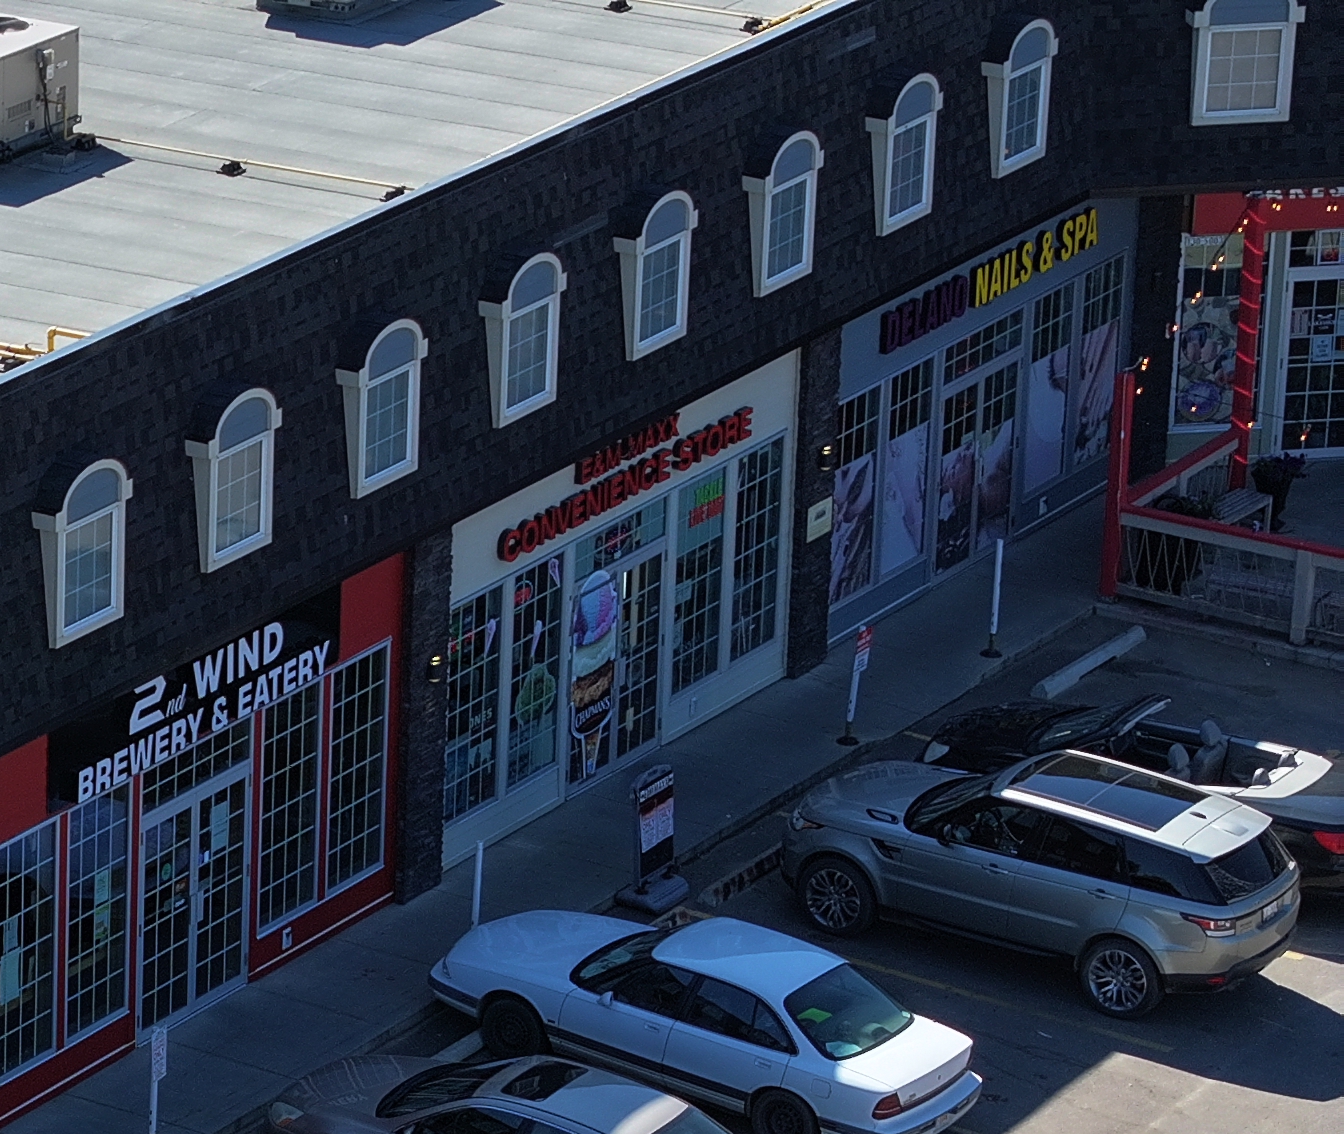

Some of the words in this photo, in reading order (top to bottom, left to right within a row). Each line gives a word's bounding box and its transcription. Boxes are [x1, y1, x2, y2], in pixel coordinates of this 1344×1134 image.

[883, 276, 968, 353] DELANO
[972, 241, 1033, 308] NAILS
[1038, 231, 1055, 273] &
[1059, 208, 1098, 261] SPA
[499, 448, 670, 562] CONVENIENCE
[672, 406, 753, 471] STORE
[78, 707, 204, 804] BREWERY
[211, 695, 229, 732] &
[237, 639, 331, 720] EATERY
[129, 674, 188, 736] 2nd
[193, 621, 284, 699] WIND
